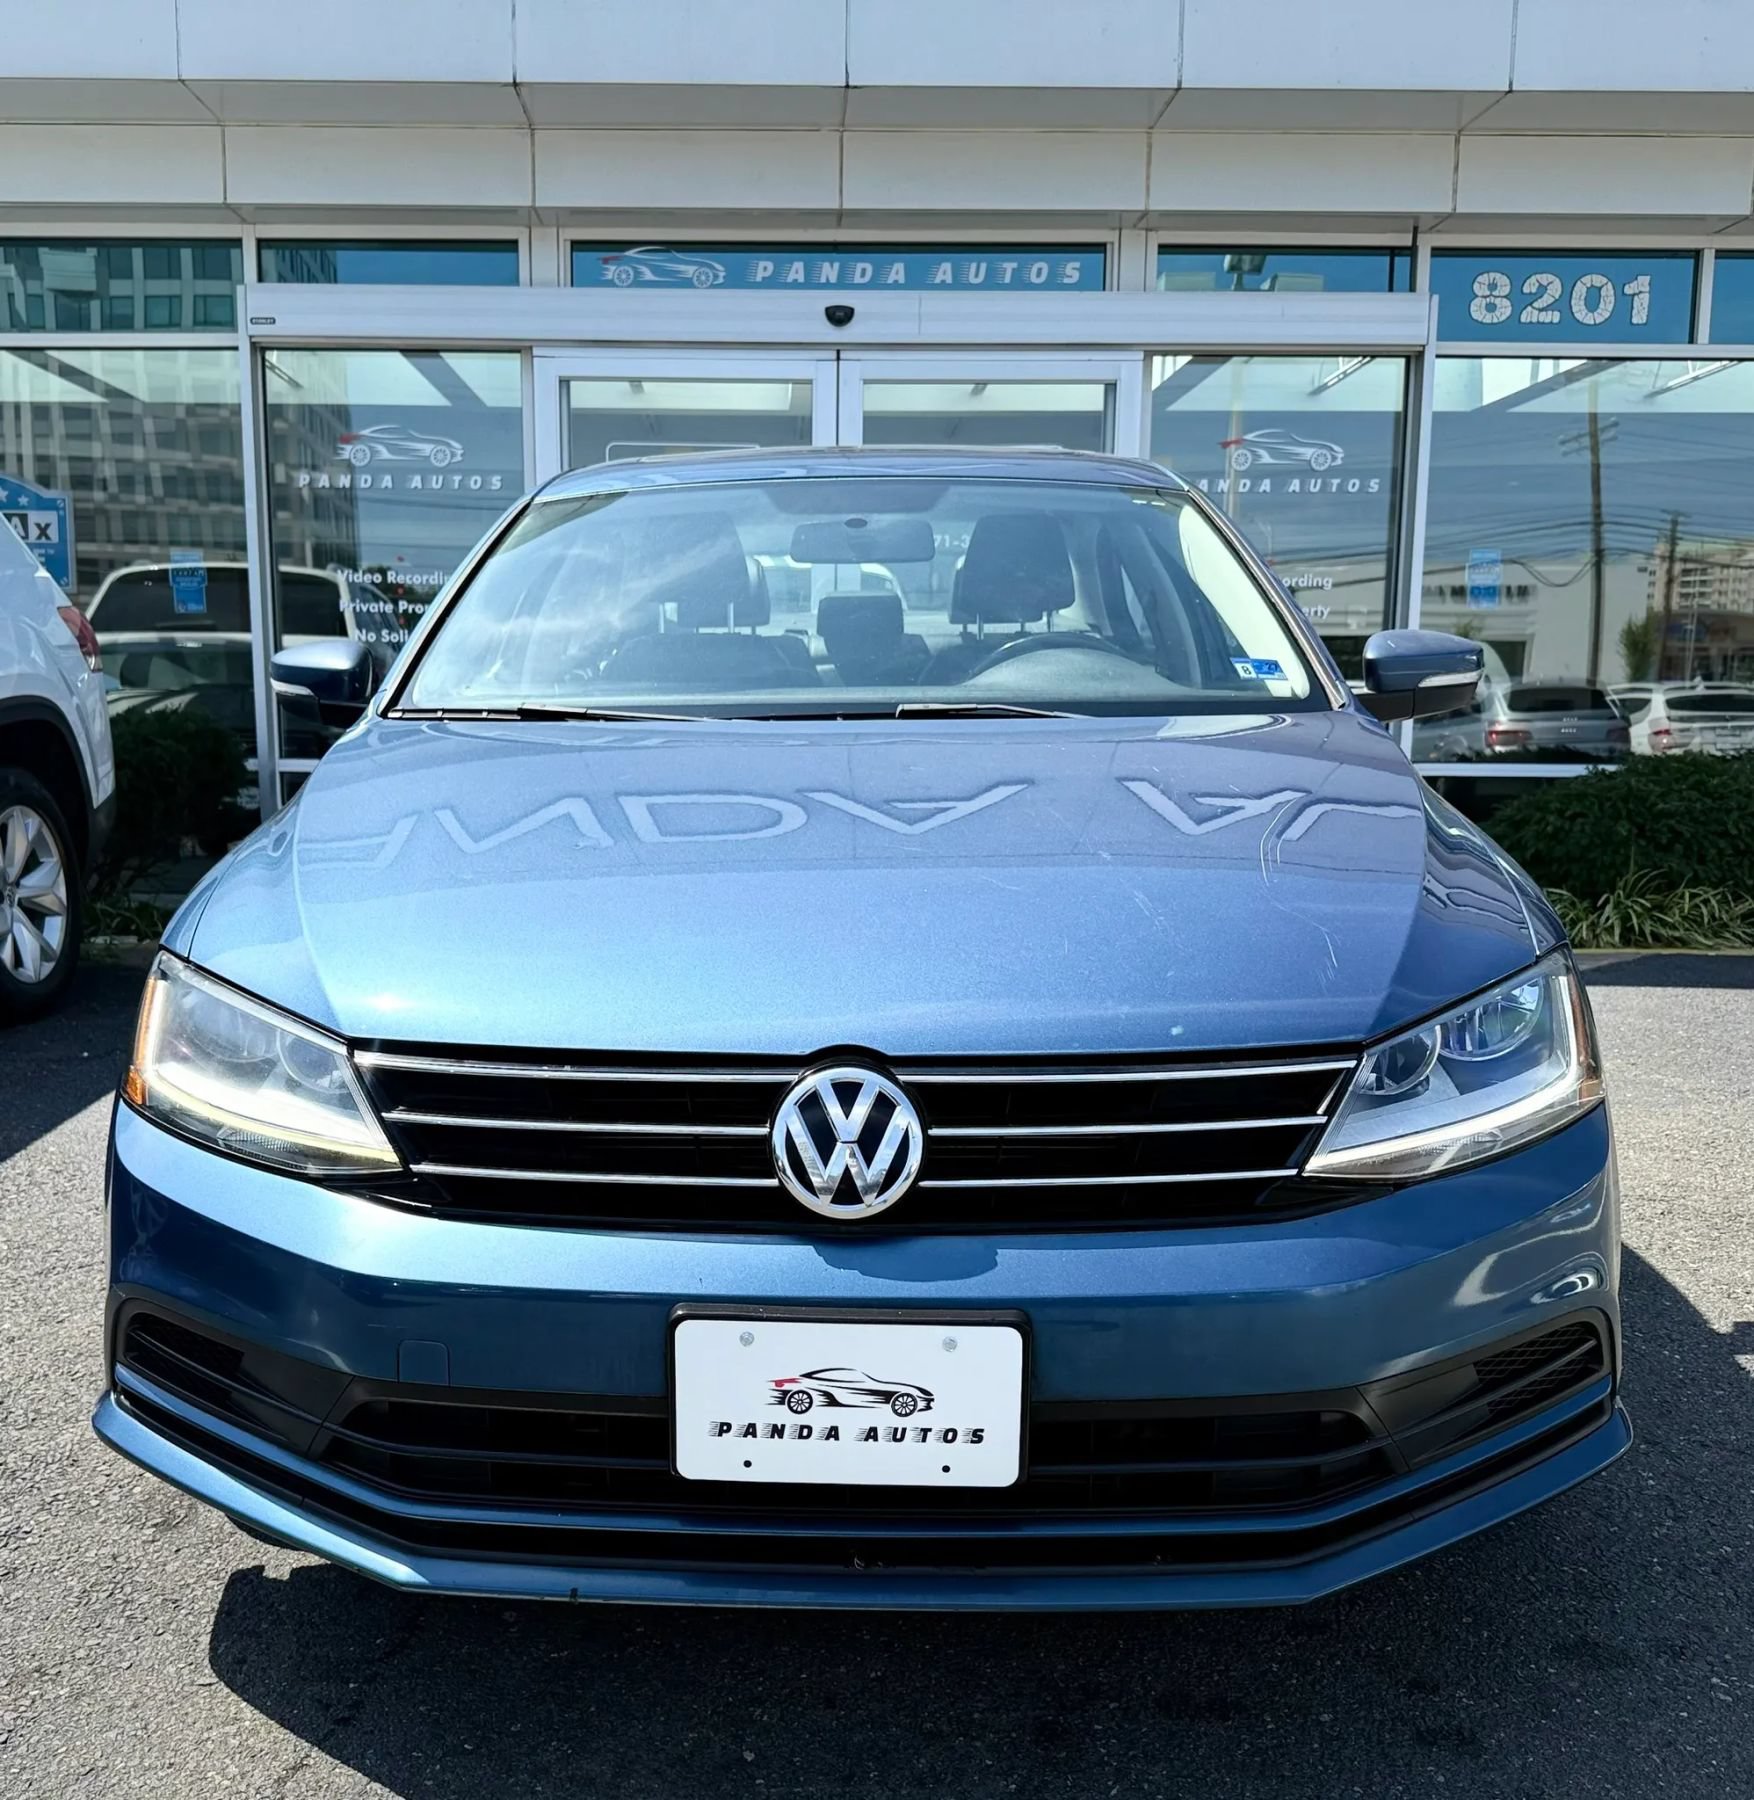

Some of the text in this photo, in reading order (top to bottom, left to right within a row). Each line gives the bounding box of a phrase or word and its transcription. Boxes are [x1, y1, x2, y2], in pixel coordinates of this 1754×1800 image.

[749, 260, 1081, 285] PANDA AUTOS
[1469, 271, 1651, 325] 8201
[298, 474, 503, 490] PANDA AUTOS
[1287, 478, 1381, 493] AUTOS
[337, 569, 383, 585] Video
[339, 599, 394, 615] Private
[356, 629, 377, 643] No
[707, 1421, 985, 1444] PANDA AUTOS
